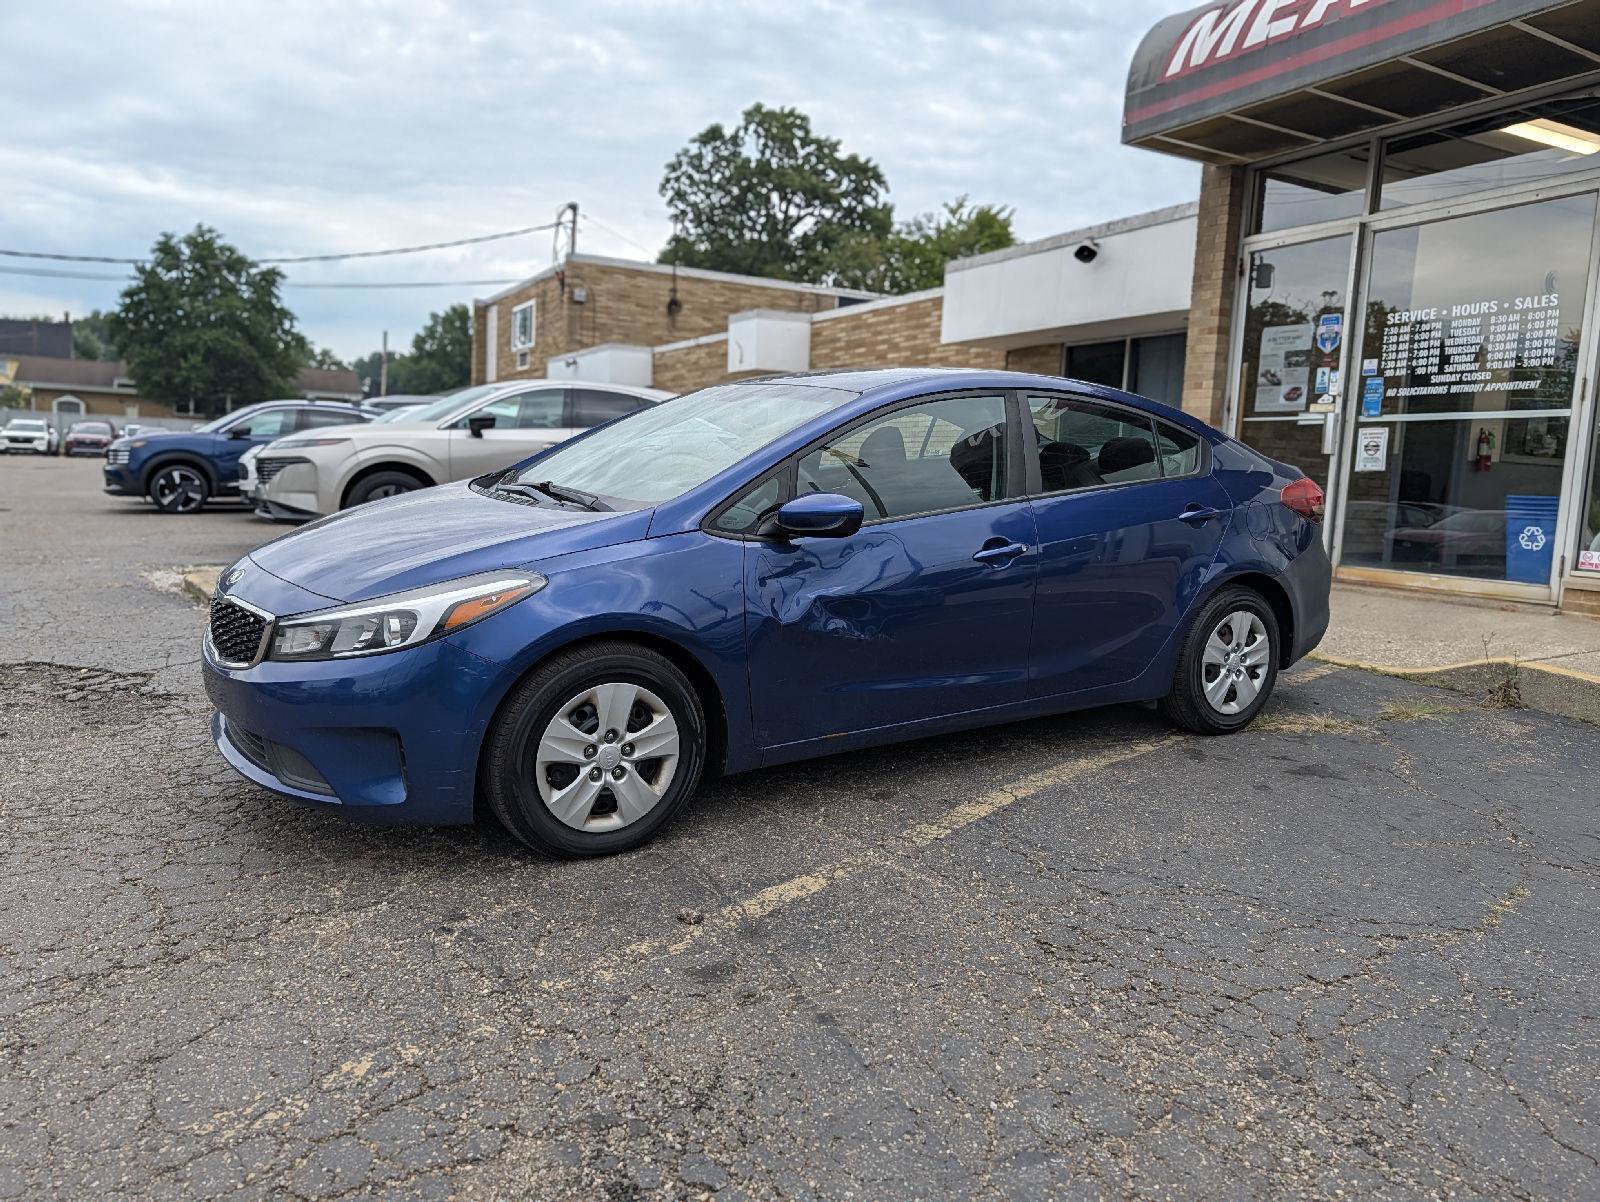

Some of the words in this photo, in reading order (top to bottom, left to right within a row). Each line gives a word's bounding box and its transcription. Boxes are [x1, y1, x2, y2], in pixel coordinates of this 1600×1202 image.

[1387, 308, 1436, 325] SERVICE
[1453, 301, 1497, 317] HOURS
[1515, 294, 1558, 310] SALES
[1400, 325, 1410, 334] AM
[1432, 322, 1441, 331] PM
[1452, 318, 1480, 328] MONDAY
[1491, 315, 1506, 324] 8:30
[1451, 327, 1480, 337] TUESDAY
[1528, 321, 1544, 330] 6:00
[1445, 336, 1484, 347] WEDNESDAY
[1490, 334, 1505, 343] 9:00
[1398, 351, 1408, 360] AM
[1430, 348, 1439, 357] PM
[1445, 345, 1480, 355] THURSDAY
[1488, 343, 1503, 352] 8:30
[1525, 340, 1541, 349] 8:00
[1428, 357, 1439, 366] PM
[1450, 354, 1475, 363] FRIDAY
[1488, 352, 1503, 361] 9:00
[1524, 349, 1540, 358] 6:00
[1543, 348, 1555, 357] PM
[1395, 368, 1406, 377] AM
[1428, 366, 1438, 375] PM
[1444, 363, 1480, 373] SATURDAY
[1487, 361, 1502, 370] 9:00
[1504, 360, 1515, 369] AM
[1523, 359, 1539, 368] 3:00
[1431, 374, 1460, 384] SUNDAY
[1462, 372, 1491, 382] CLOSED
[1386, 388, 1397, 397] NO
[1397, 385, 1448, 397] SOLICITATIONS
[1450, 384, 1484, 394] WITHOUT
[1485, 381, 1541, 392] APPOINTMENT
